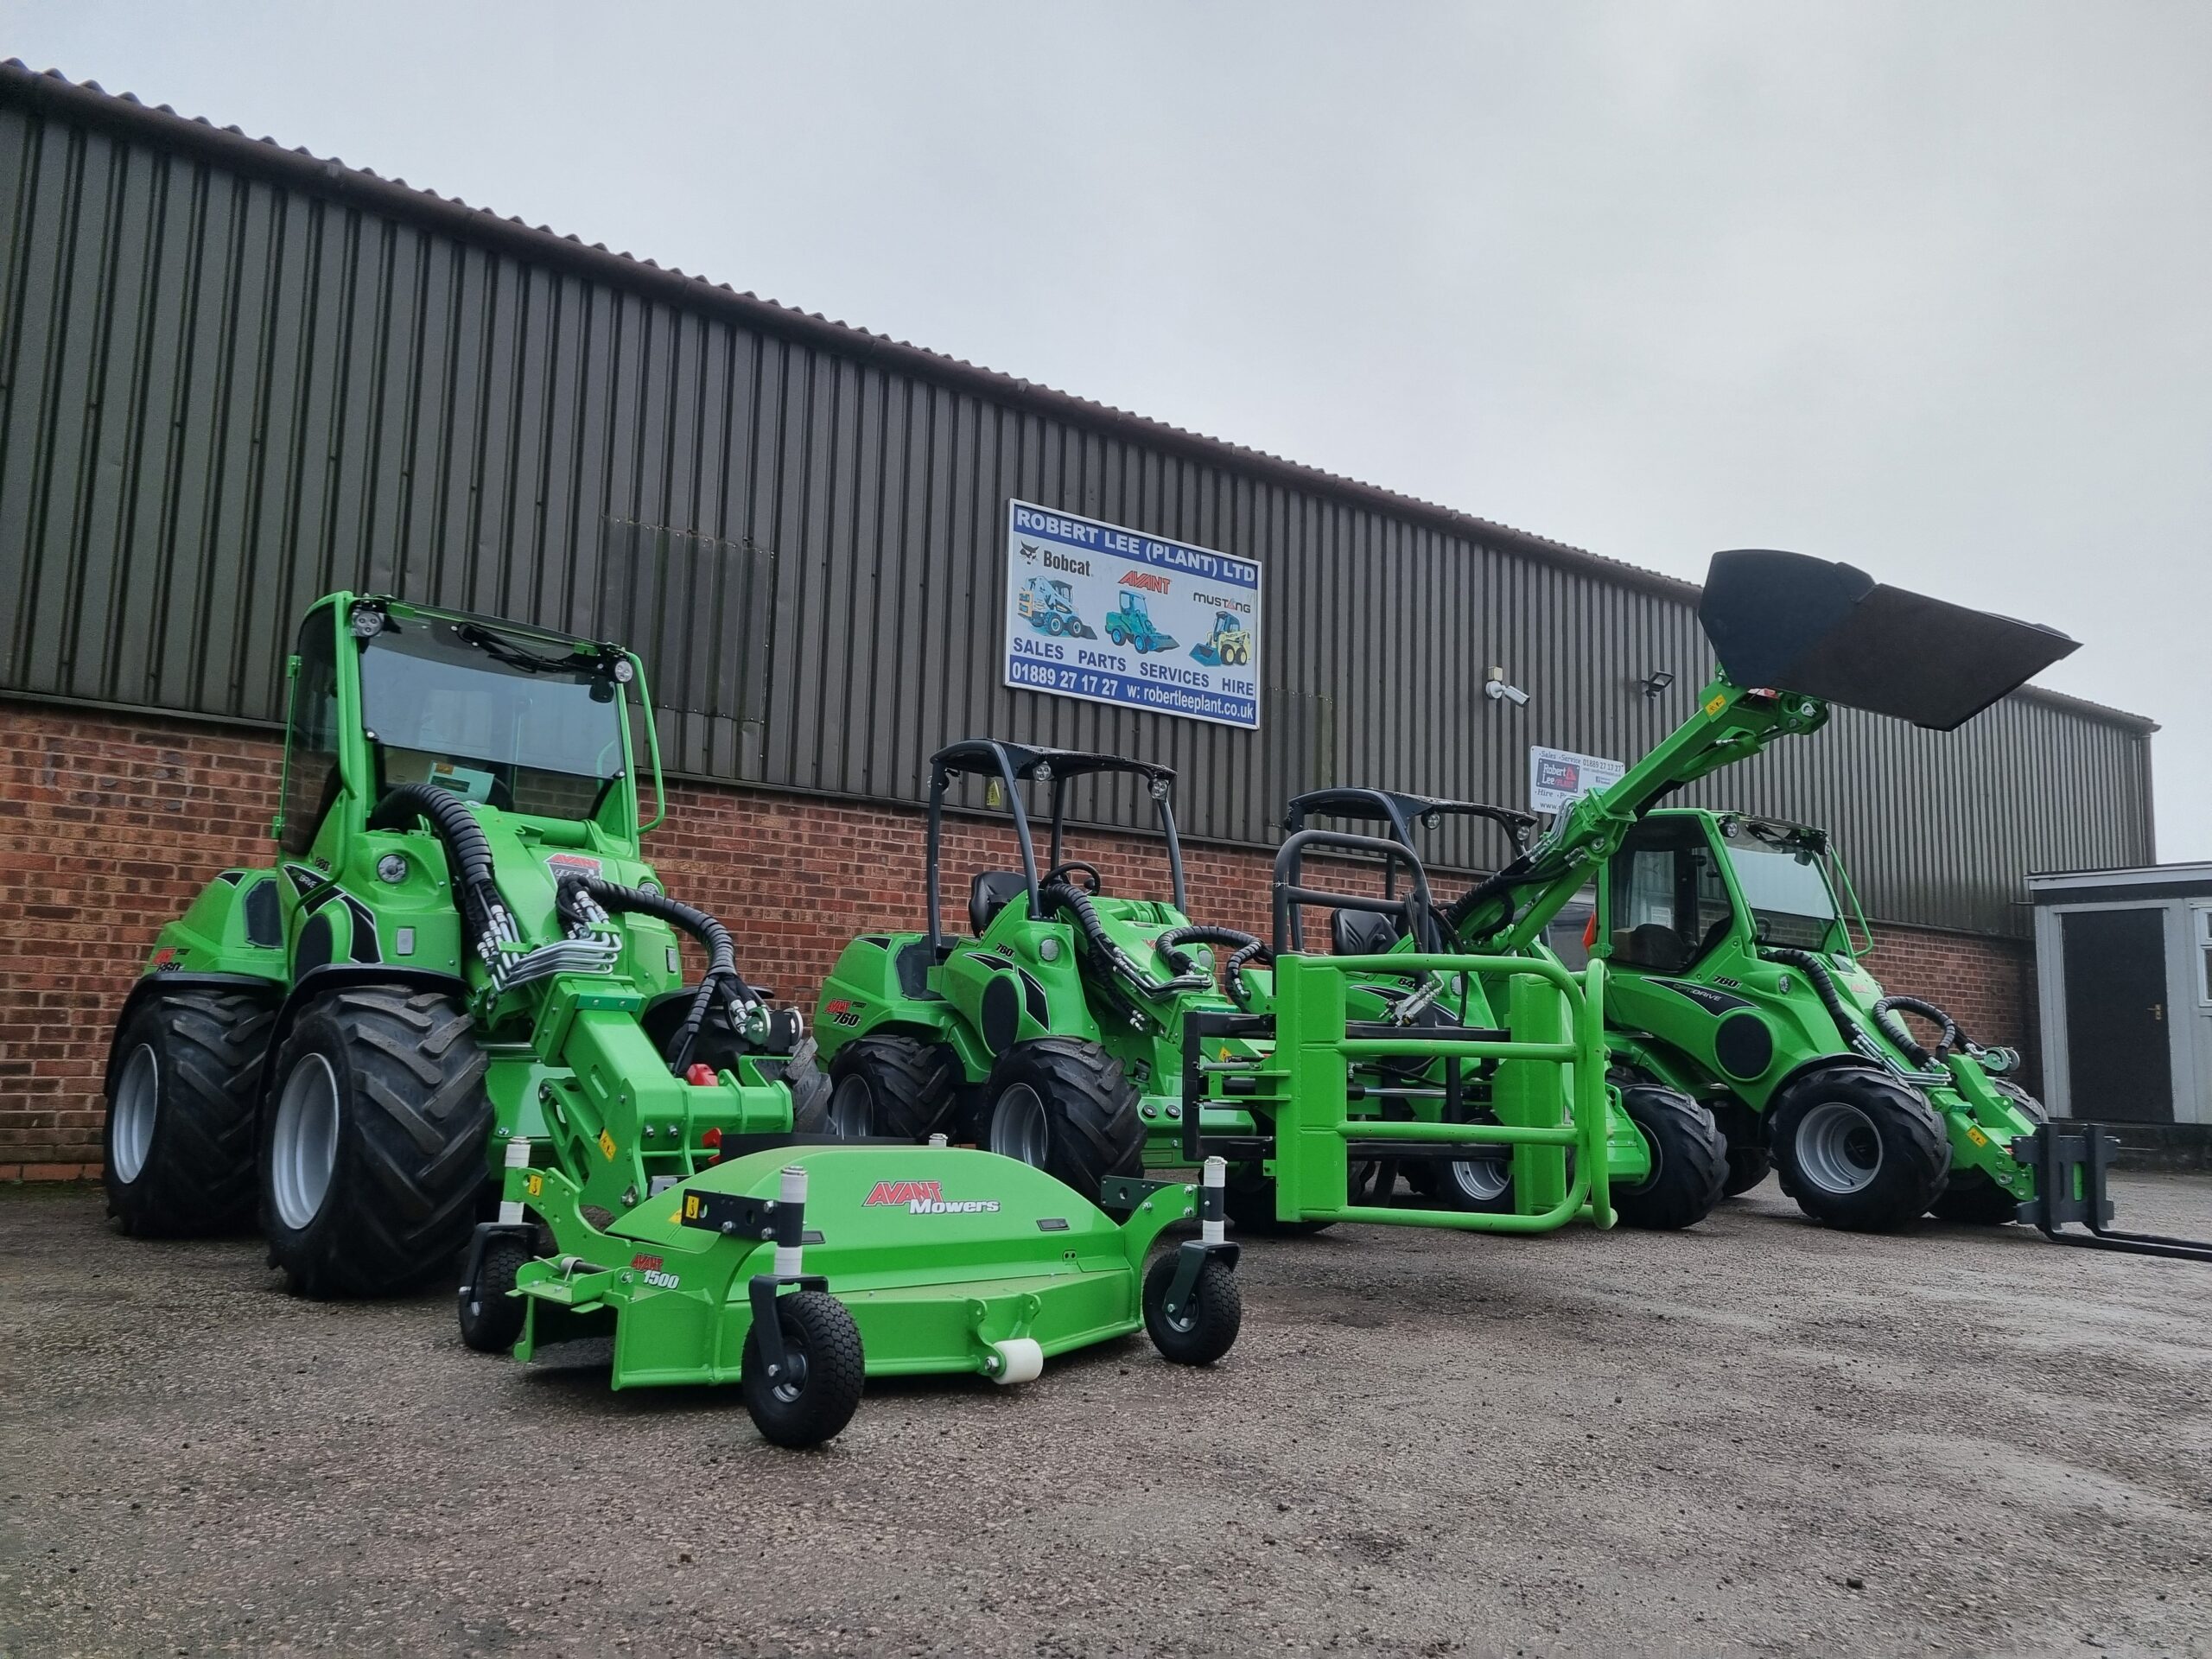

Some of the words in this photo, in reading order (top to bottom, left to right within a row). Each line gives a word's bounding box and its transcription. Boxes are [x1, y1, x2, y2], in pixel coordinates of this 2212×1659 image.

[1016, 508, 1099, 544] ROBERT
[1104, 531, 1140, 556] LEE
[1146, 542, 1218, 577] (PLANT)
[1223, 558, 1255, 582] LTD
[1043, 550, 1090, 577] Bobcat
[1116, 569, 1172, 595] AVANT
[1013, 637, 1065, 660] SALES
[1077, 649, 1128, 672] PARTS
[1139, 661, 1210, 688] SERVICES
[1221, 677, 1255, 696] HIRE
[1012, 662, 1057, 686] 01889
[1059, 670, 1077, 690] 27
[1081, 674, 1098, 693] 17
[1101, 678, 1119, 696] 27
[1126, 683, 1141, 699] w:
[1143, 685, 1254, 720] robertleeplant.co.uk
[1541, 773, 1555, 785] Lee
[1542, 763, 1567, 777] Robert
[832, 1012, 861, 1027] 760
[862, 1180, 944, 1207] AVANT
[909, 1198, 1001, 1215] Mowers
[642, 1269, 680, 1290] 1500
